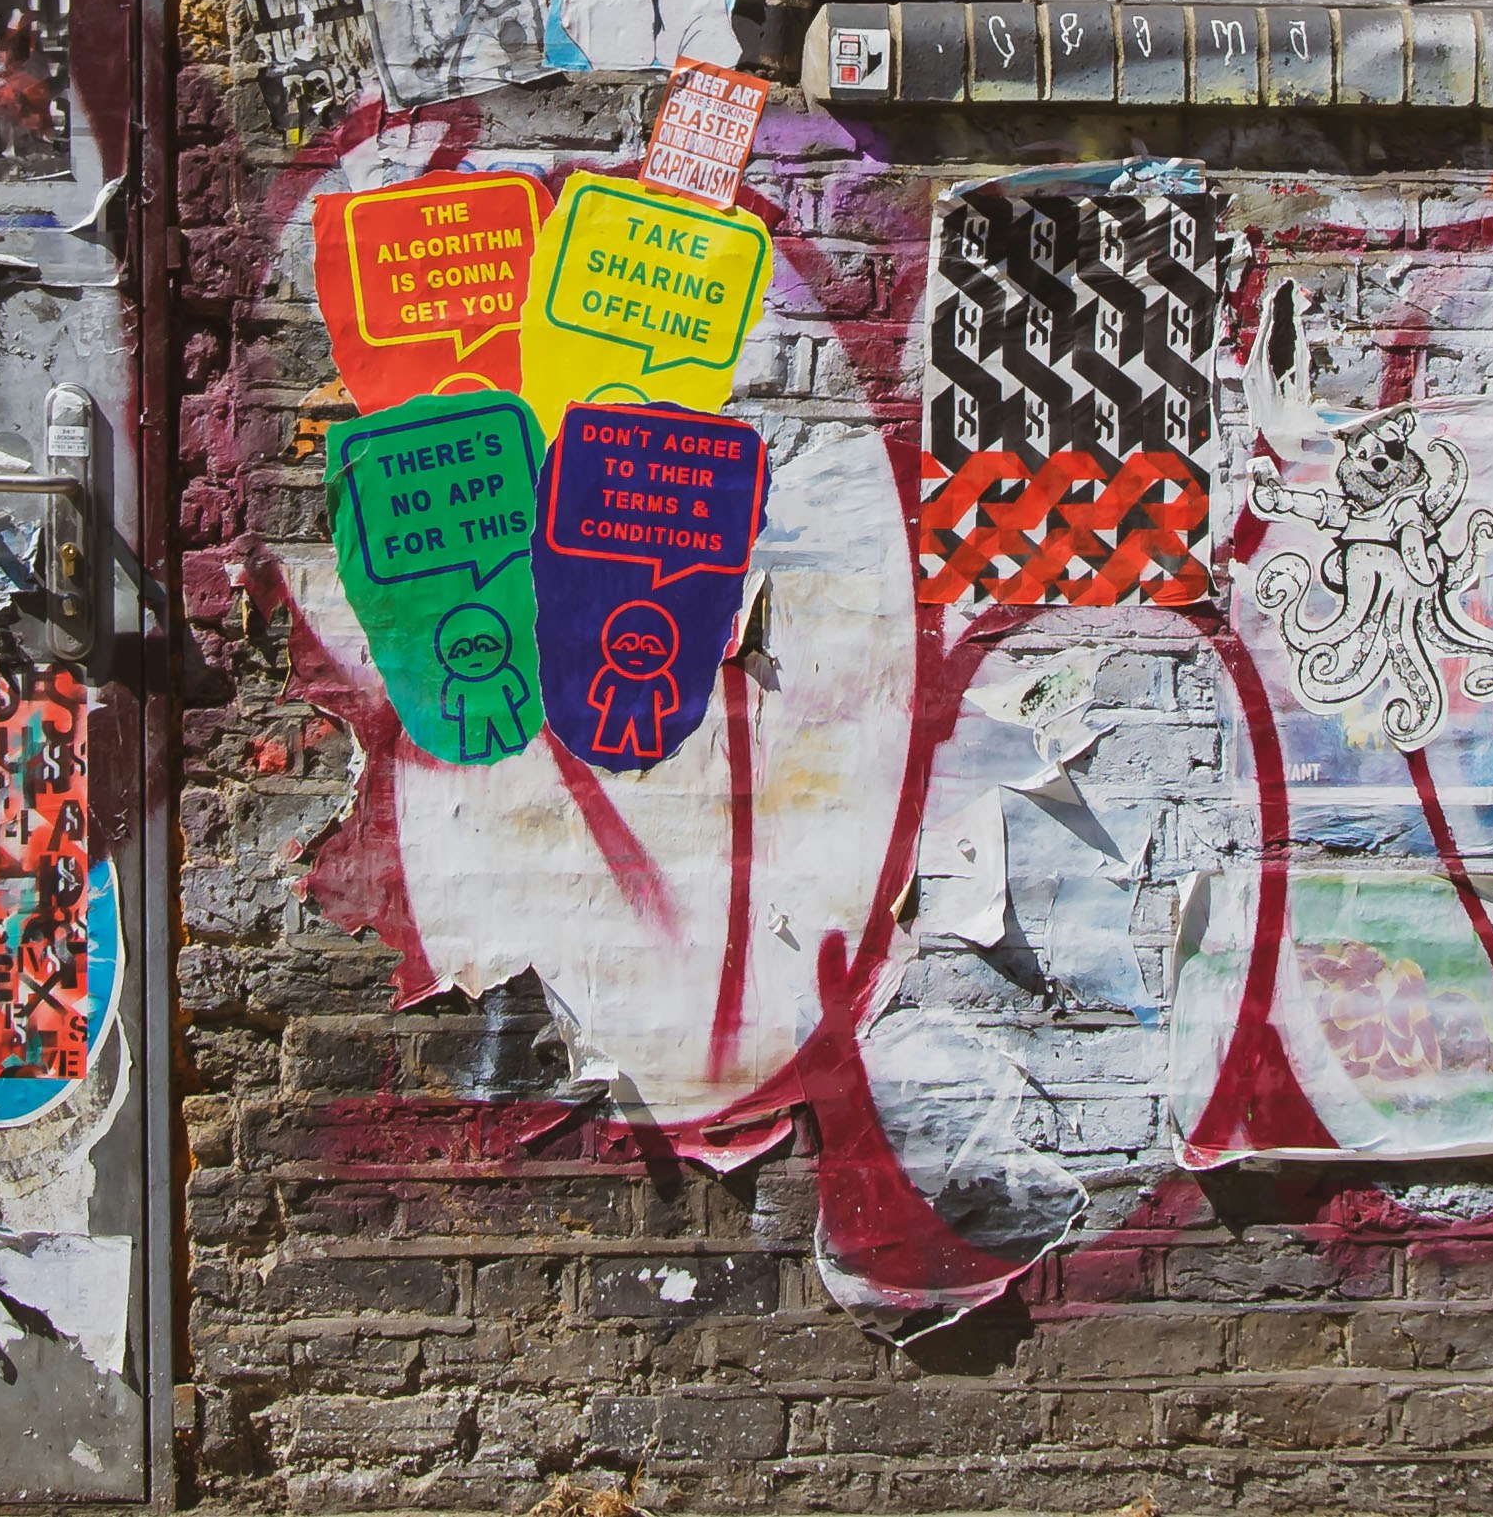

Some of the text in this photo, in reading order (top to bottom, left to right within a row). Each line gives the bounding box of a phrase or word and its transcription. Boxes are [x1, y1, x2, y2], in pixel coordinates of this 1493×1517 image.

[675, 69, 763, 109] STREET ART
[686, 91, 704, 106] THE
[706, 98, 754, 122] STICKING
[666, 100, 749, 144] PLASTER
[649, 147, 736, 202] CAPITALISM
[420, 202, 469, 227] THE
[377, 228, 523, 264] ALGORITHM
[626, 216, 709, 261] TAKE
[391, 260, 515, 294] IS GONNA
[586, 249, 726, 306] SHARING
[400, 292, 514, 324] GET YOU
[581, 290, 713, 345] OFFLINE
[377, 432, 504, 480] THERE'S
[582, 423, 742, 461] DON'T AGREE
[604, 457, 715, 489] TO THEIR
[390, 473, 505, 519] NO APP
[602, 488, 711, 519] TERMS &
[384, 509, 528, 560] FOR THIS
[580, 518, 723, 553] CONDITIONS
